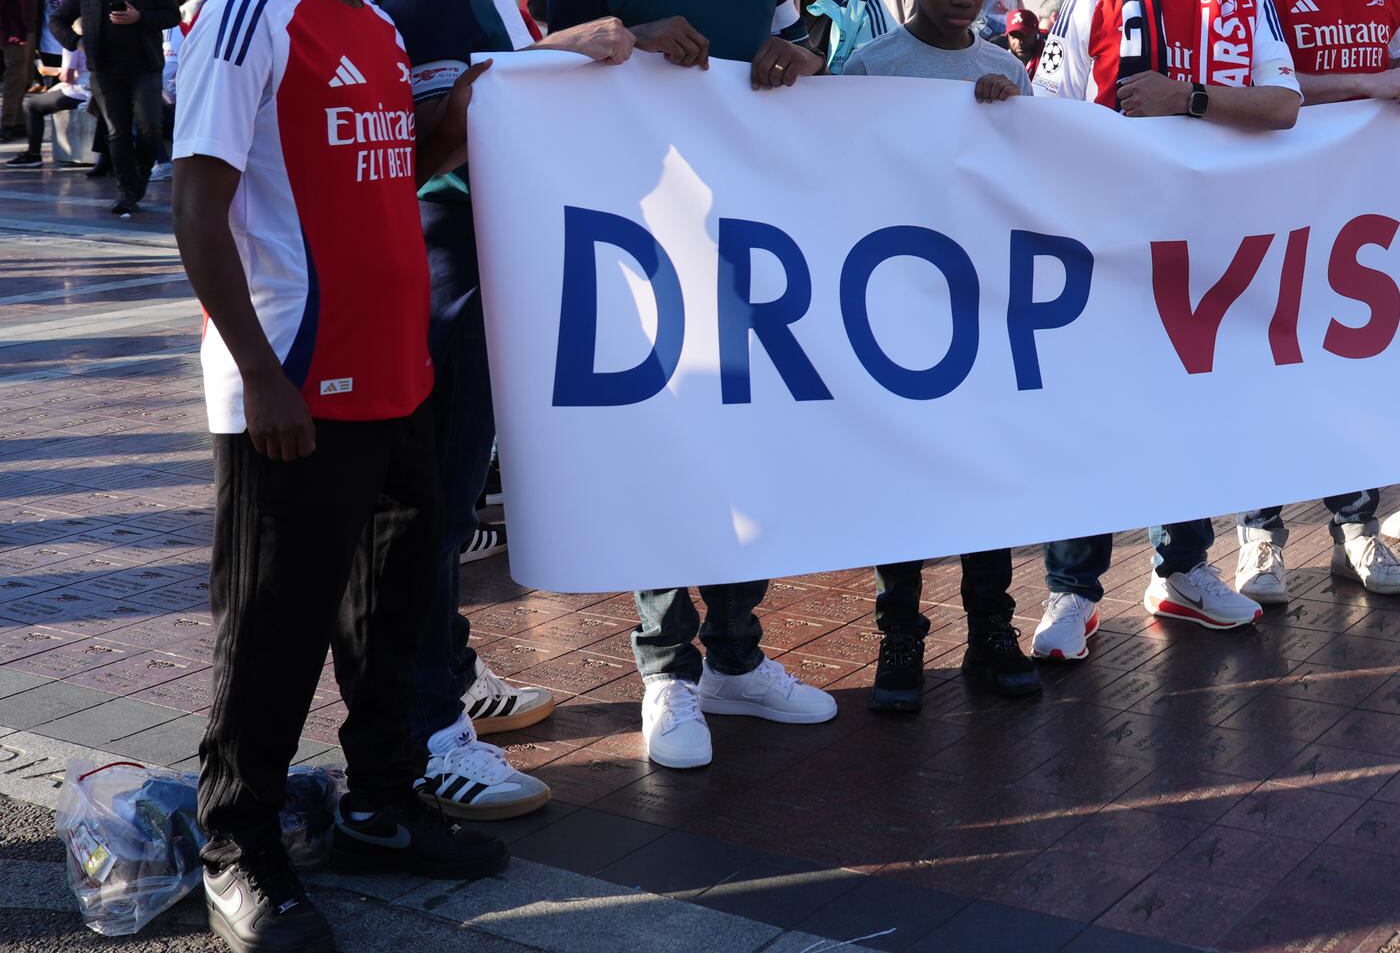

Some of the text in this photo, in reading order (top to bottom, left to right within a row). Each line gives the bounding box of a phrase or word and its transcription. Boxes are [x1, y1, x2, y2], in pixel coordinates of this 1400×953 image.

[1293, 18, 1390, 49] Emirates
[1315, 47, 1383, 71] FLY BETTER
[324, 102, 416, 146] Emirate
[356, 147, 412, 183] FLY BETT
[552, 205, 1094, 408] DROP
